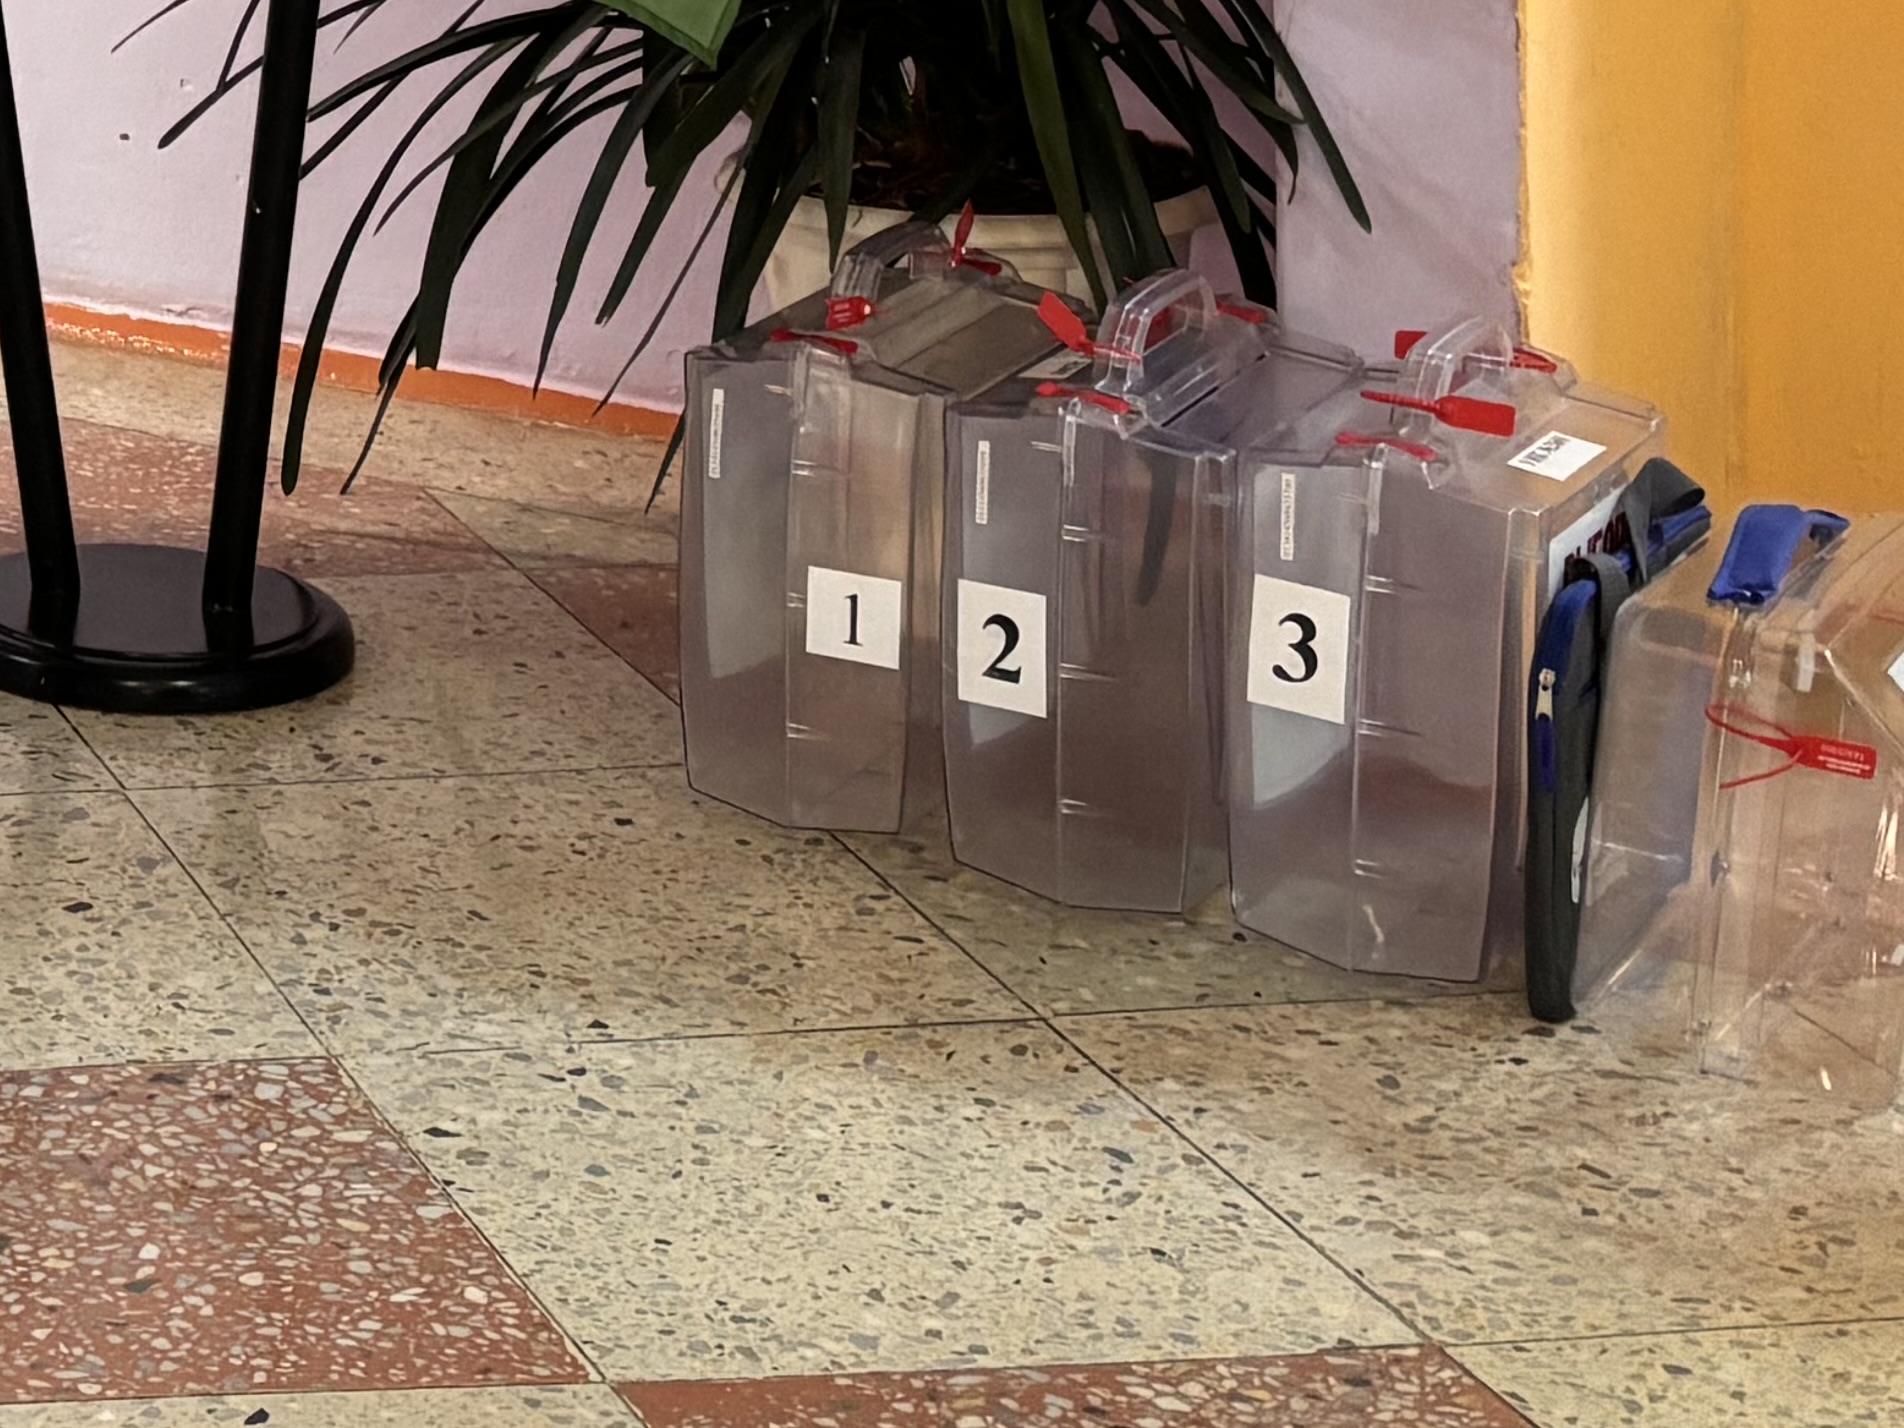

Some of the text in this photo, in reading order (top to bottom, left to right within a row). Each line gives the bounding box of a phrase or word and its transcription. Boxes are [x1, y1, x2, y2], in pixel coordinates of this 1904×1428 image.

[844, 594, 862, 646] 1
[982, 614, 1021, 684] 2
[1272, 613, 1318, 682] 3
